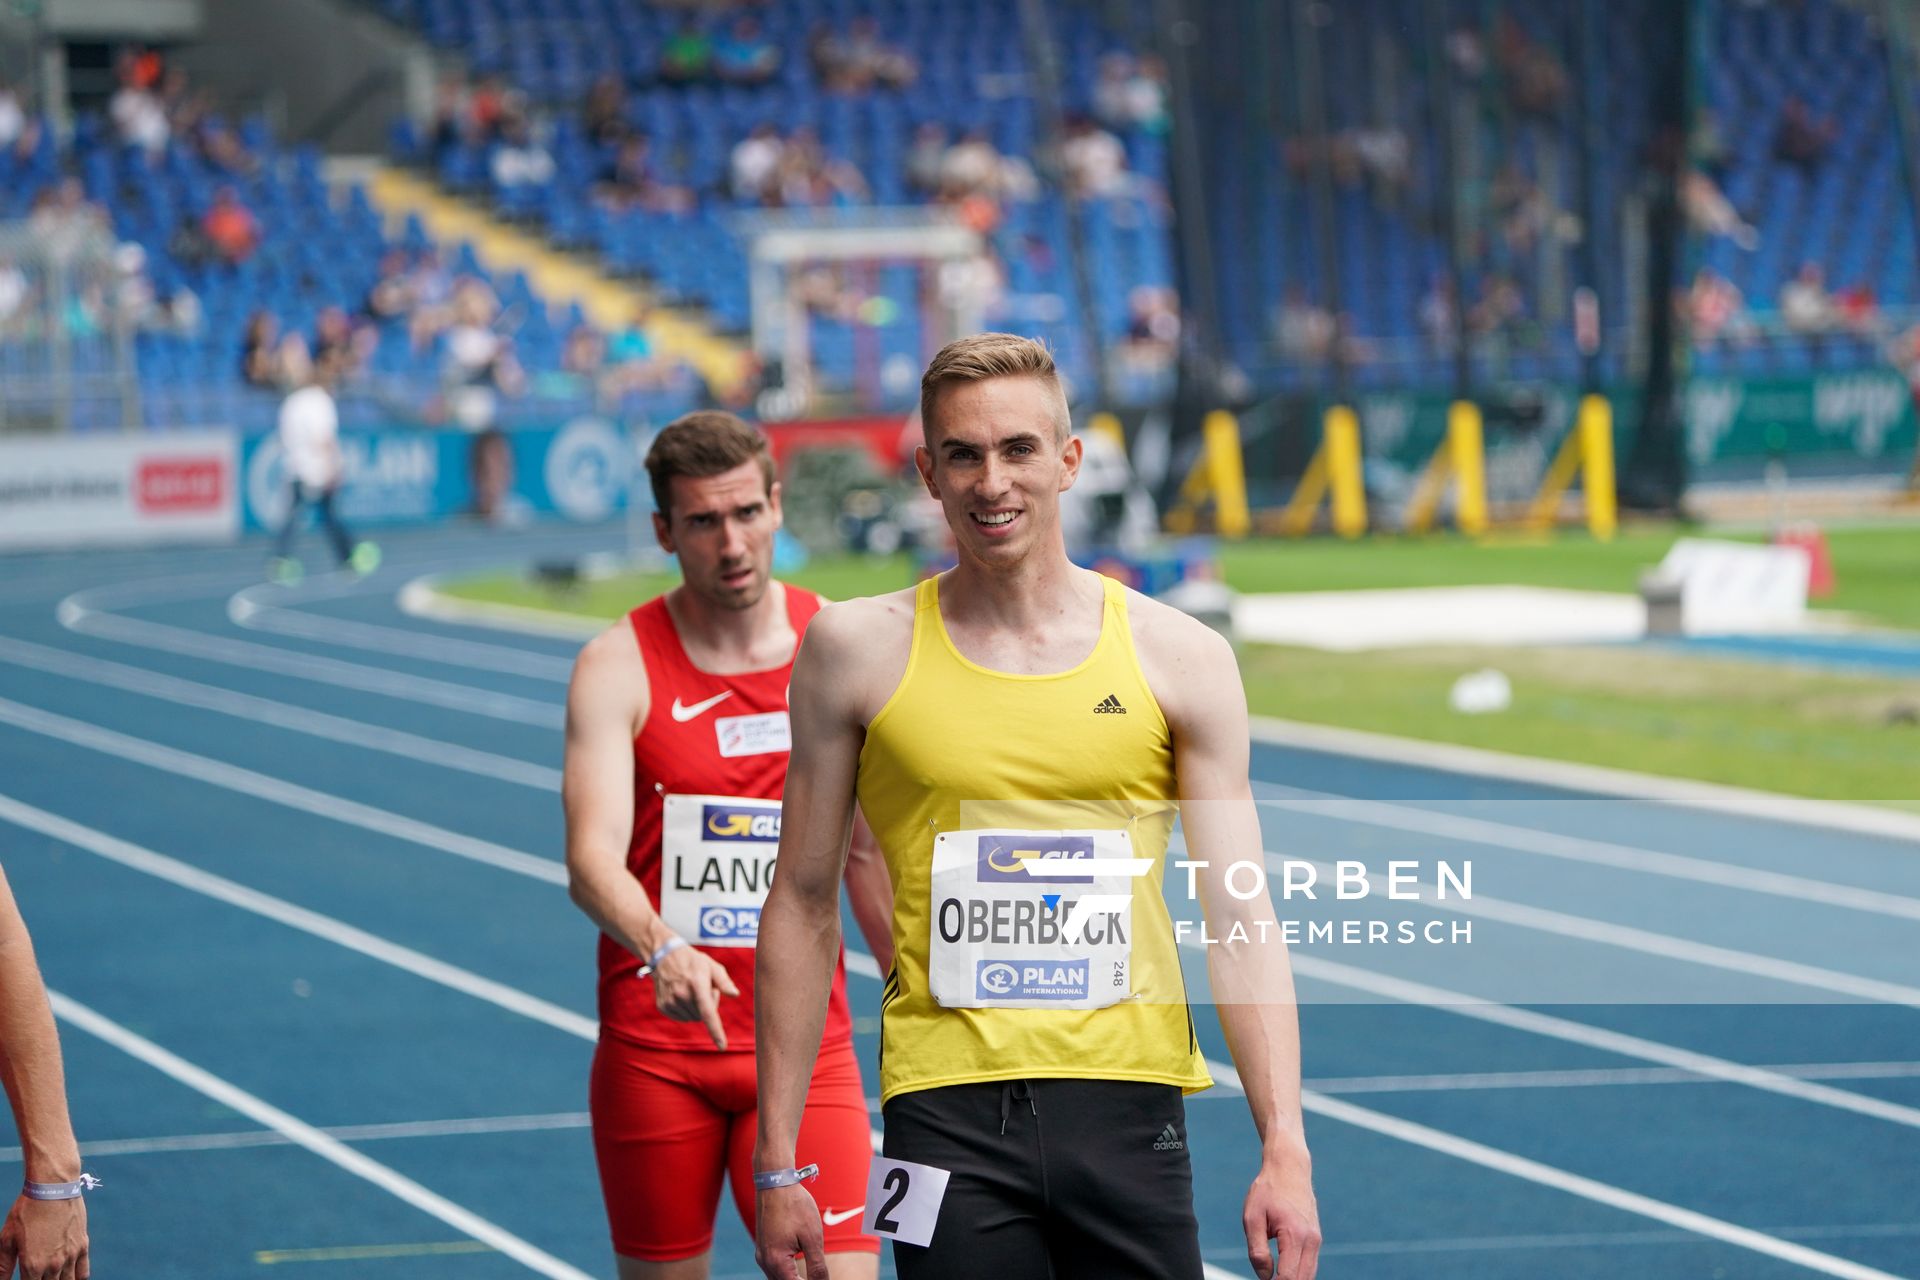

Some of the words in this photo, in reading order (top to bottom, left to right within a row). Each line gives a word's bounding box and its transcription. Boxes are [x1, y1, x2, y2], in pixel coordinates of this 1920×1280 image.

[1093, 704, 1127, 715] adidas
[1023, 967, 1084, 986] PLAN
[1113, 961, 1124, 987] 248
[1023, 987, 1084, 995] INTERNATIONAL
[1153, 1140, 1184, 1151] adidas
[874, 1167, 910, 1234] 2
